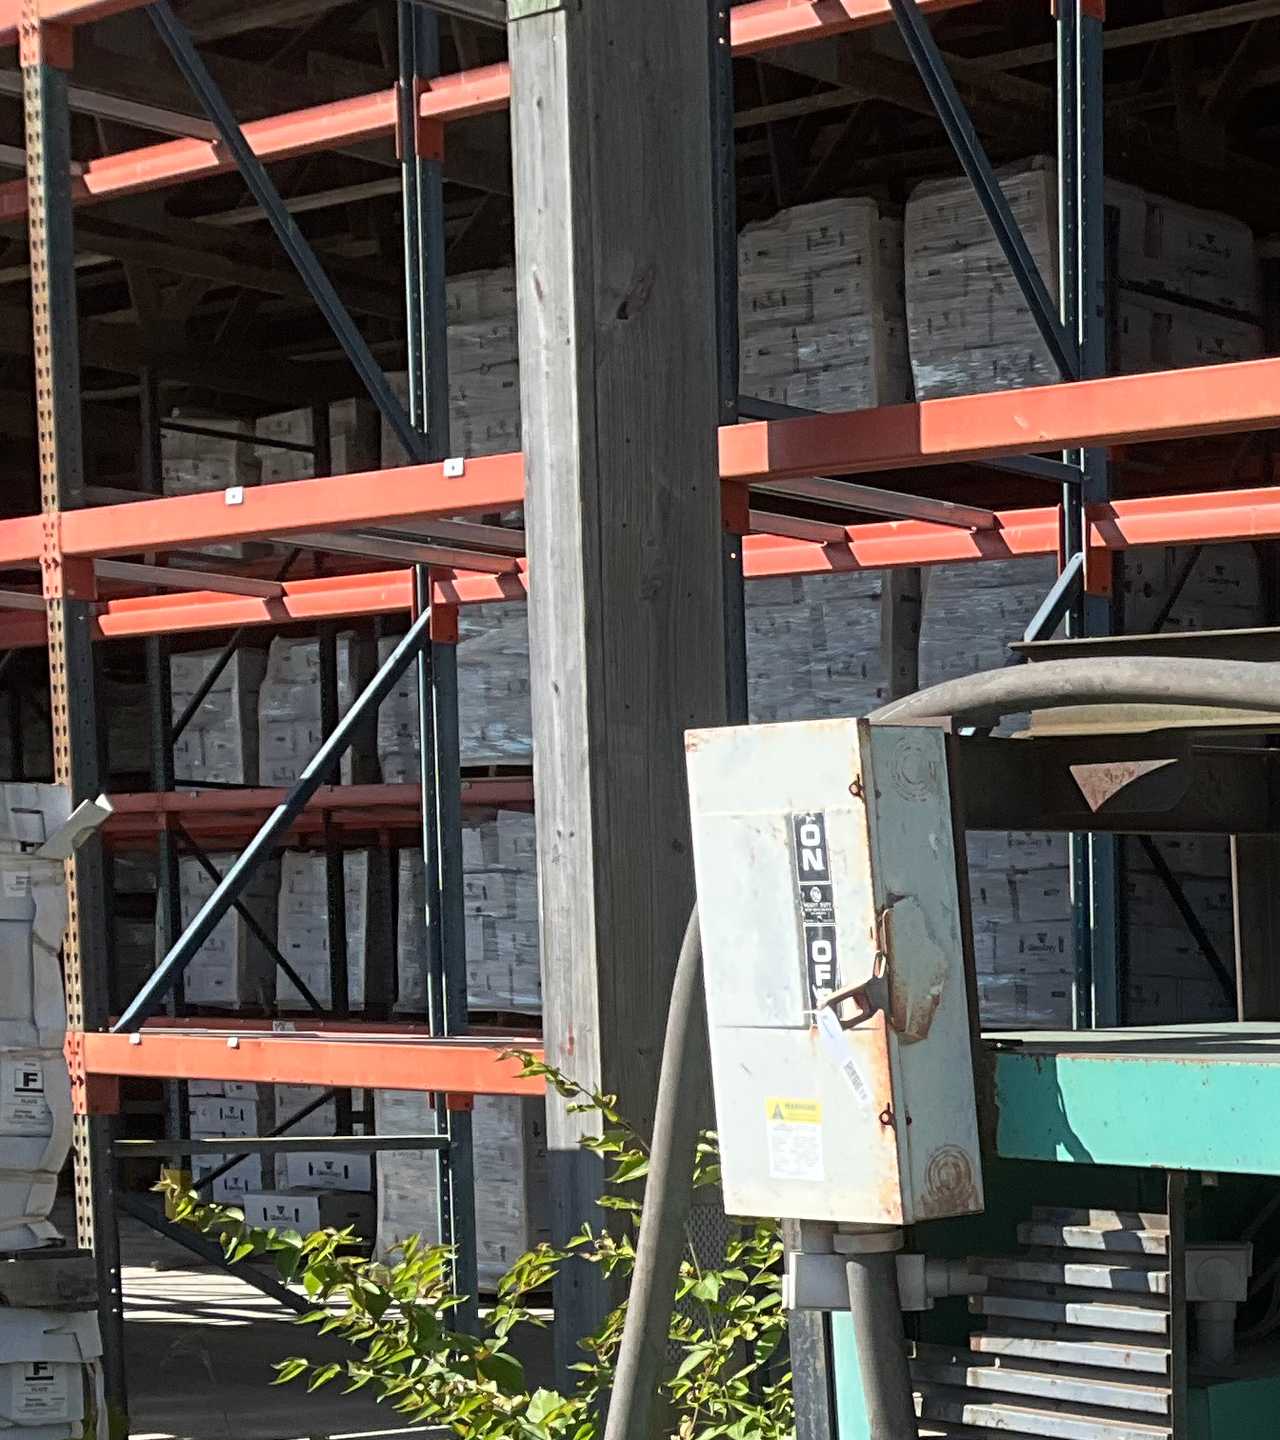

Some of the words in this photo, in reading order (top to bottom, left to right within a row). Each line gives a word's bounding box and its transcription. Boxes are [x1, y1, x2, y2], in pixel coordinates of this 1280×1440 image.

[800, 824, 825, 871] ON
[23, 1072, 38, 1087] F
[33, 1362, 48, 1375] F
